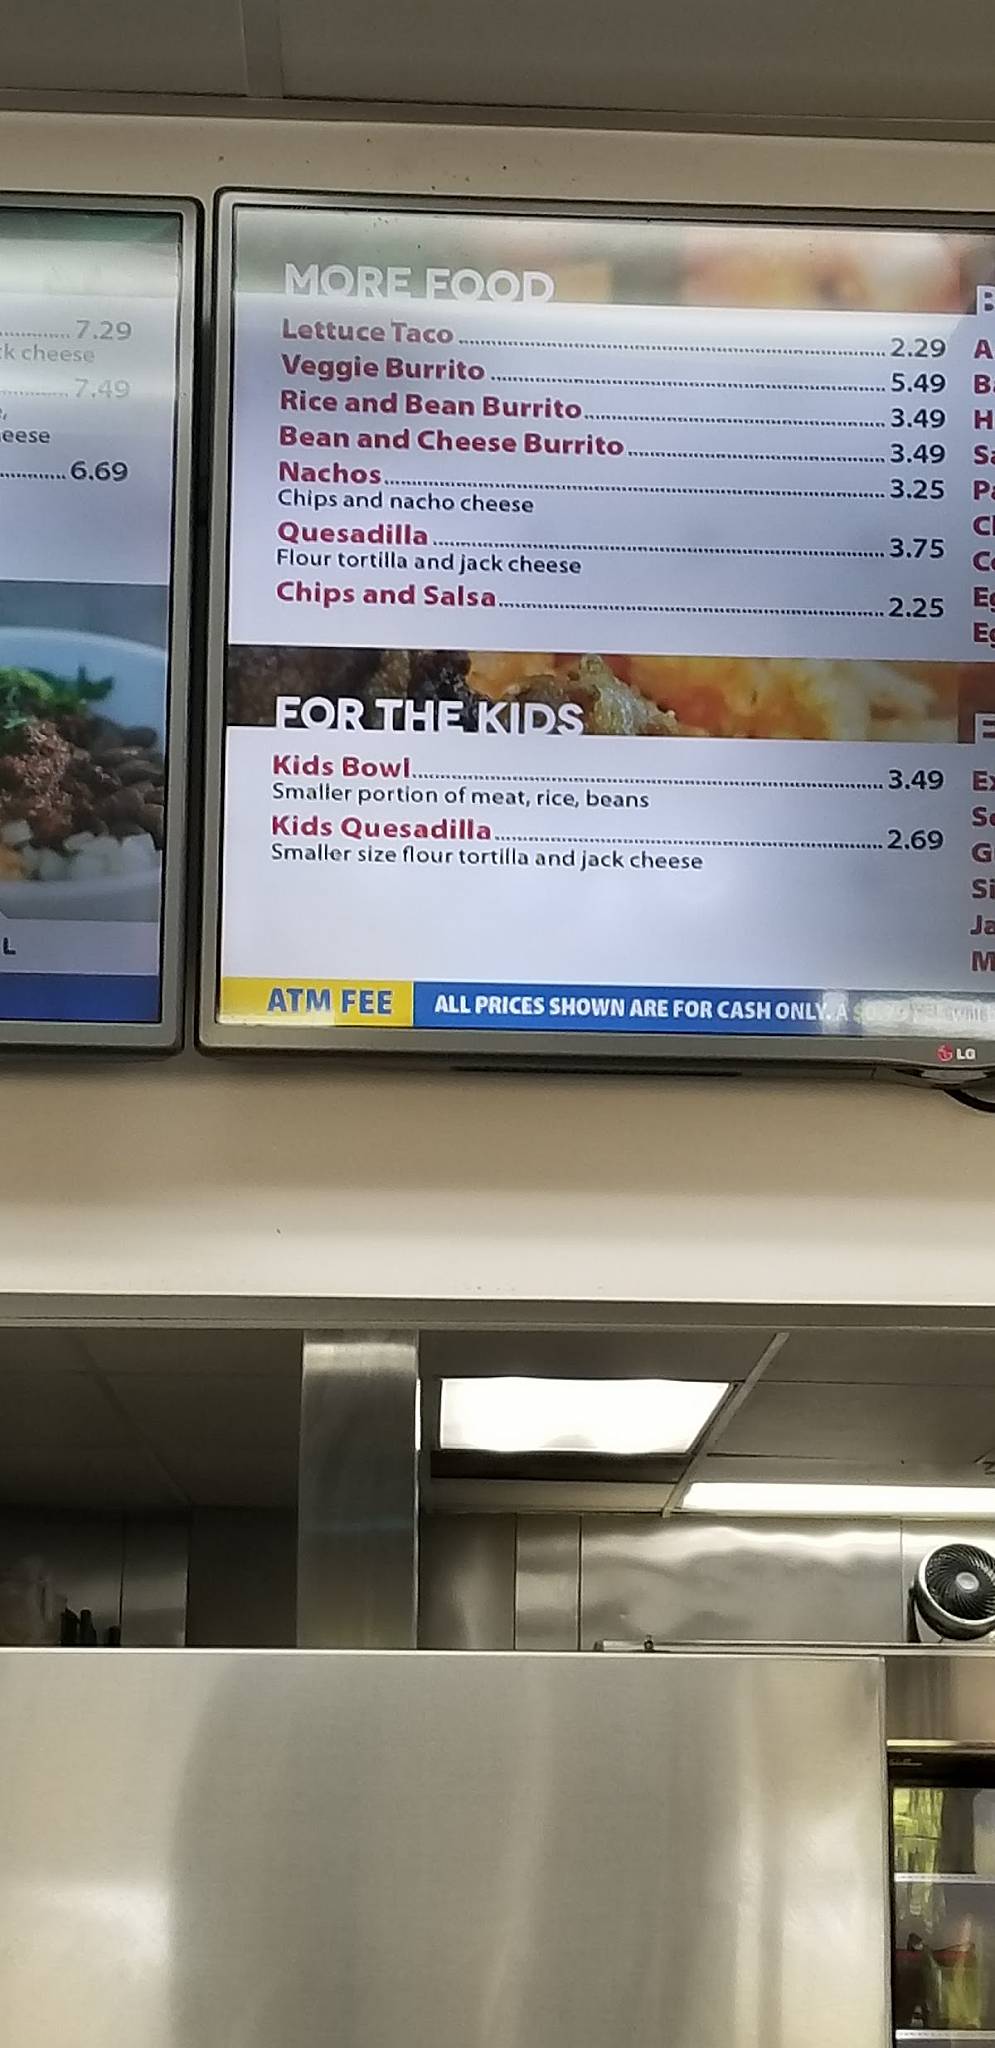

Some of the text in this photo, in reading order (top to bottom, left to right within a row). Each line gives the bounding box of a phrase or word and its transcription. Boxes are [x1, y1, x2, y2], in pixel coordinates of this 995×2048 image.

[284, 263, 554, 304] MORE FOOD
[75, 320, 132, 340] 7.29
[282, 318, 947, 358] Lettuce Taco 2.29
[21, 344, 95, 363] cheese
[74, 378, 131, 398] 7.49
[281, 353, 947, 394] Veggie Burrito 5.49
[280, 390, 947, 429] Rice and Bean Burrito 3.49
[0, 430, 51, 444] eese
[279, 426, 947, 465] Bean and Cheese Burrito 3.49
[70, 460, 129, 482] 6.69
[278, 461, 946, 500] Nachos 3.25
[278, 489, 535, 514] Chips and nacho cheese
[277, 521, 946, 560] Quesadilla 3.75
[276, 549, 583, 576] Flour tortilla and jack cheese
[276, 581, 945, 619] Chips and Salsa 2.25
[274, 696, 585, 736] FOR THE KIDS
[272, 754, 945, 791] Kids Bowl 3.49
[272, 782, 650, 810] Smaller portion of meat, rice, beans
[271, 815, 944, 851] Kids Quesadilla 2.69
[271, 842, 705, 872] Smaller size flour tortilla and jack cheese
[266, 988, 394, 1016] ATM FEE
[434, 993, 472, 1015] ALL
[475, 995, 546, 1017] PRICES
[549, 996, 625, 1018] SHOWN
[630, 998, 670, 1018] ARE
[673, 999, 712, 1018] FOR
[716, 1000, 772, 1020] CASH
[775, 1001, 831, 1021] ONLY.
[836, 1003, 849, 1021] A
[956, 1048, 977, 1061] LG
